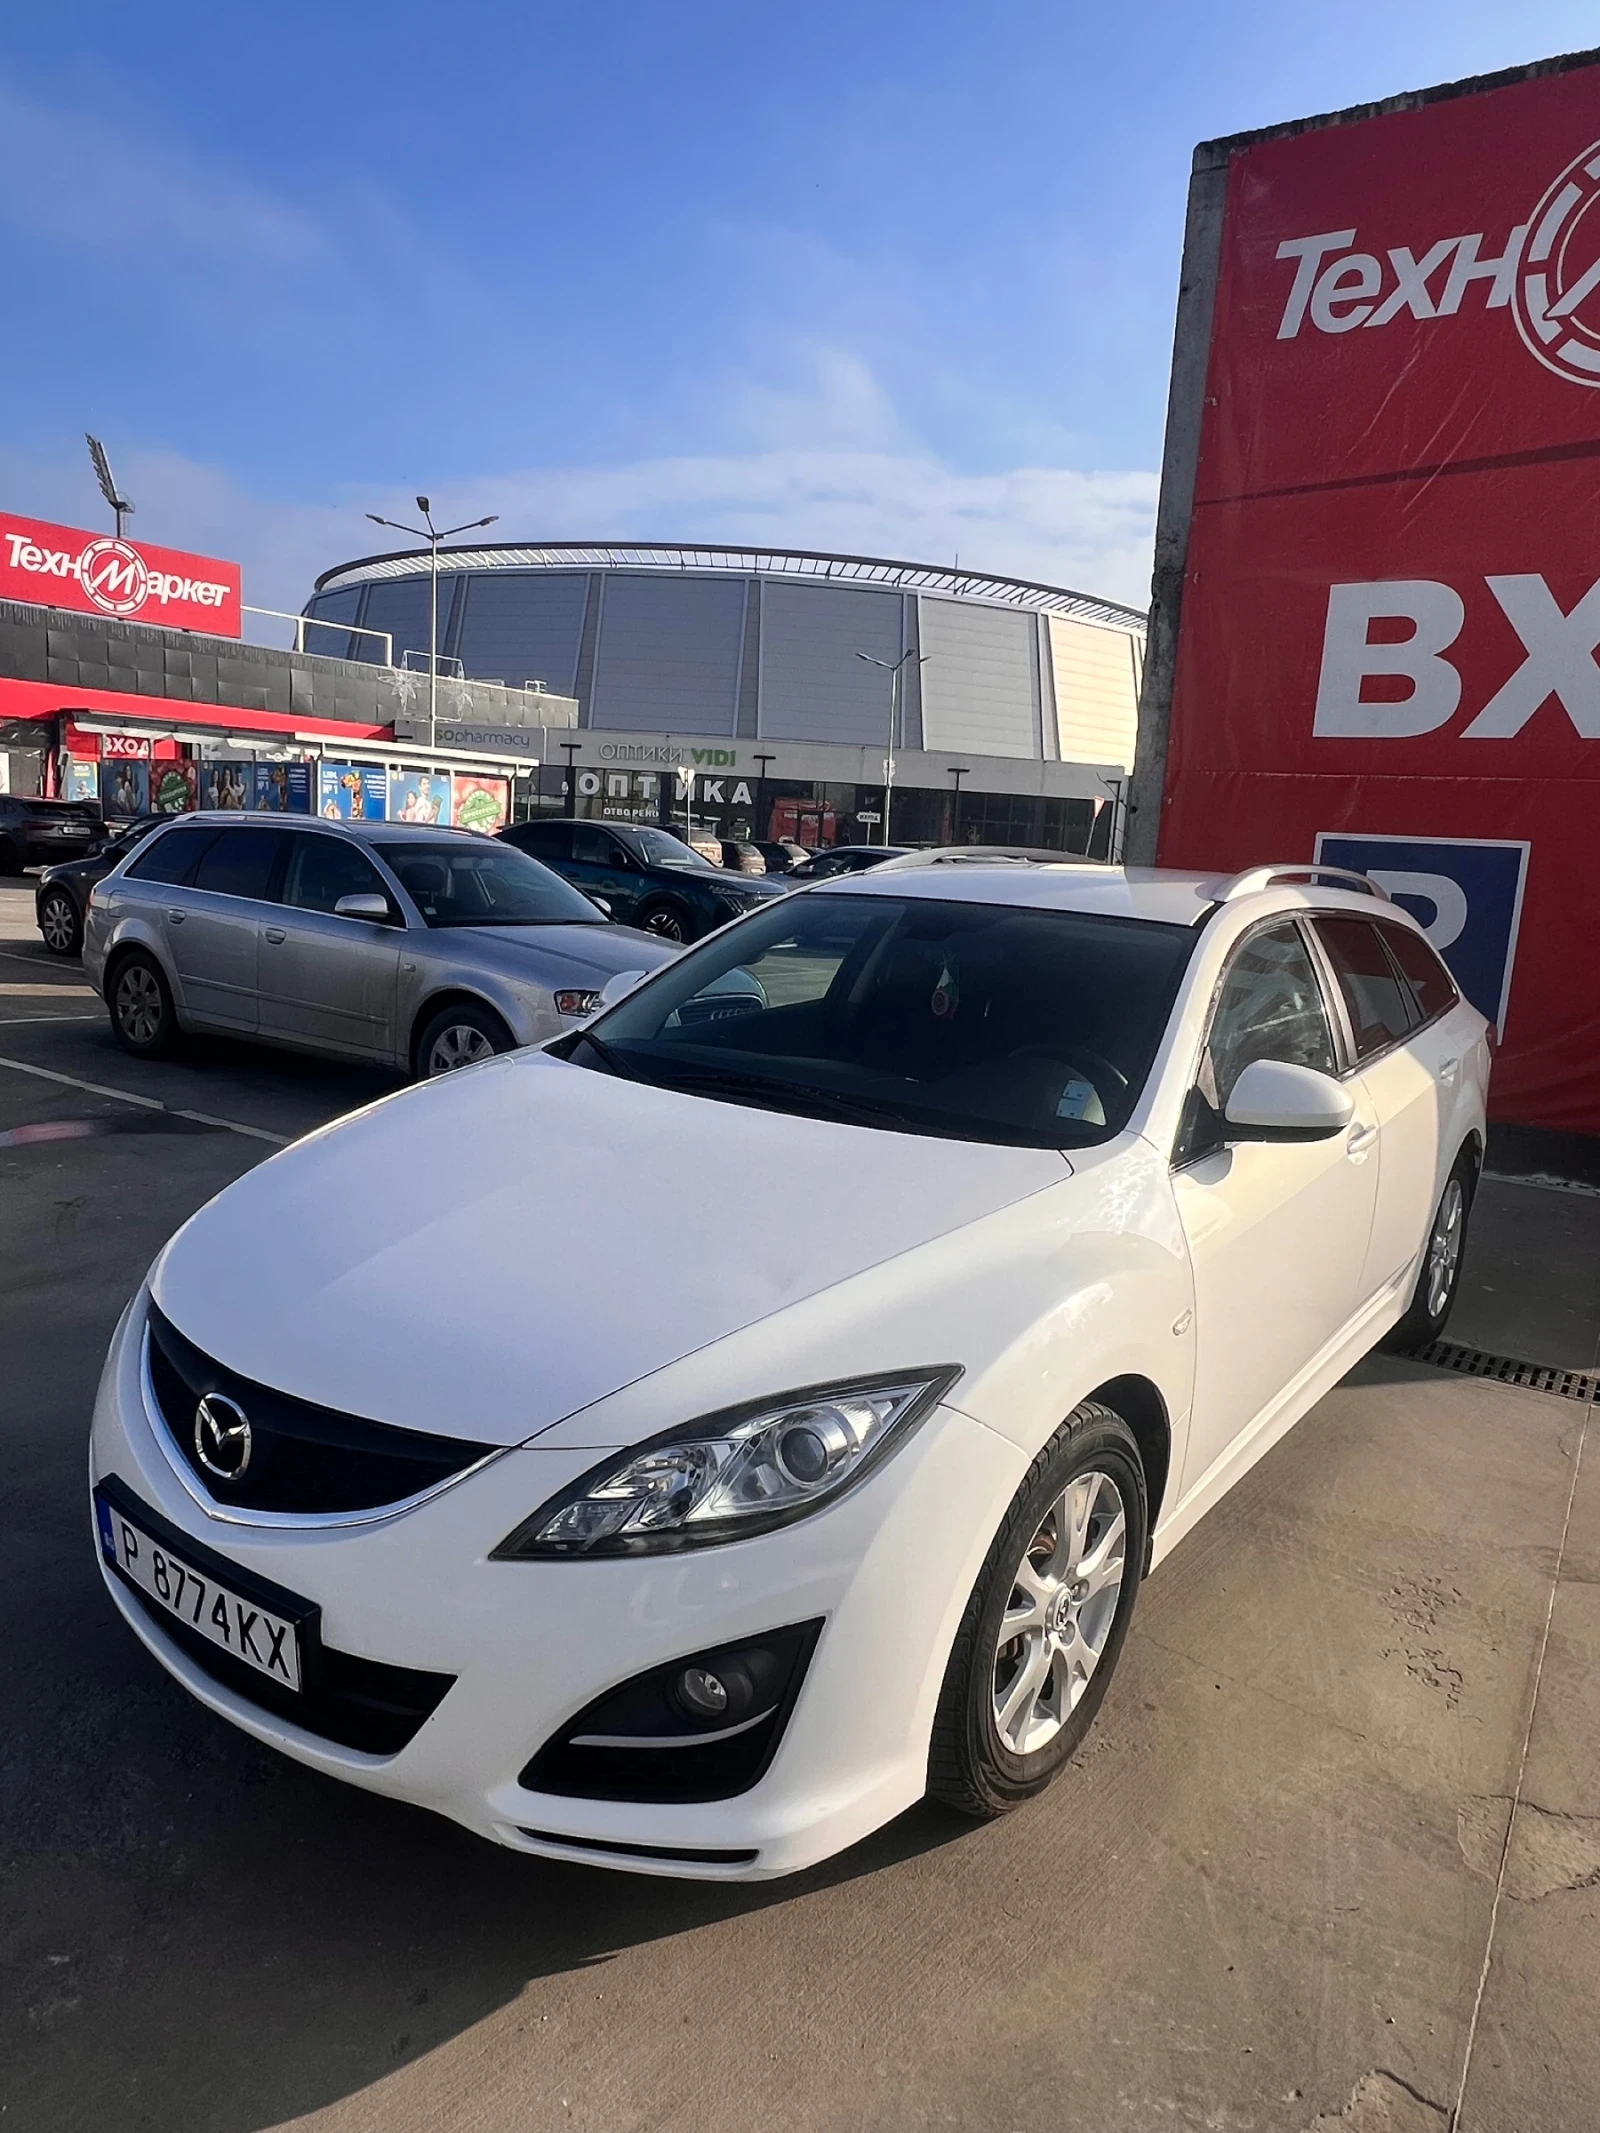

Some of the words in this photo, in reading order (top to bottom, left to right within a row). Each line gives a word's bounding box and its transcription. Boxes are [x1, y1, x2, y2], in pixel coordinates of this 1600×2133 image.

[599, 743, 684, 763] ОПТИКИ
[691, 747, 737, 767] VIDI
[578, 772, 753, 805] ОПТИКА
[152, 1550, 292, 1679] 8774KX
